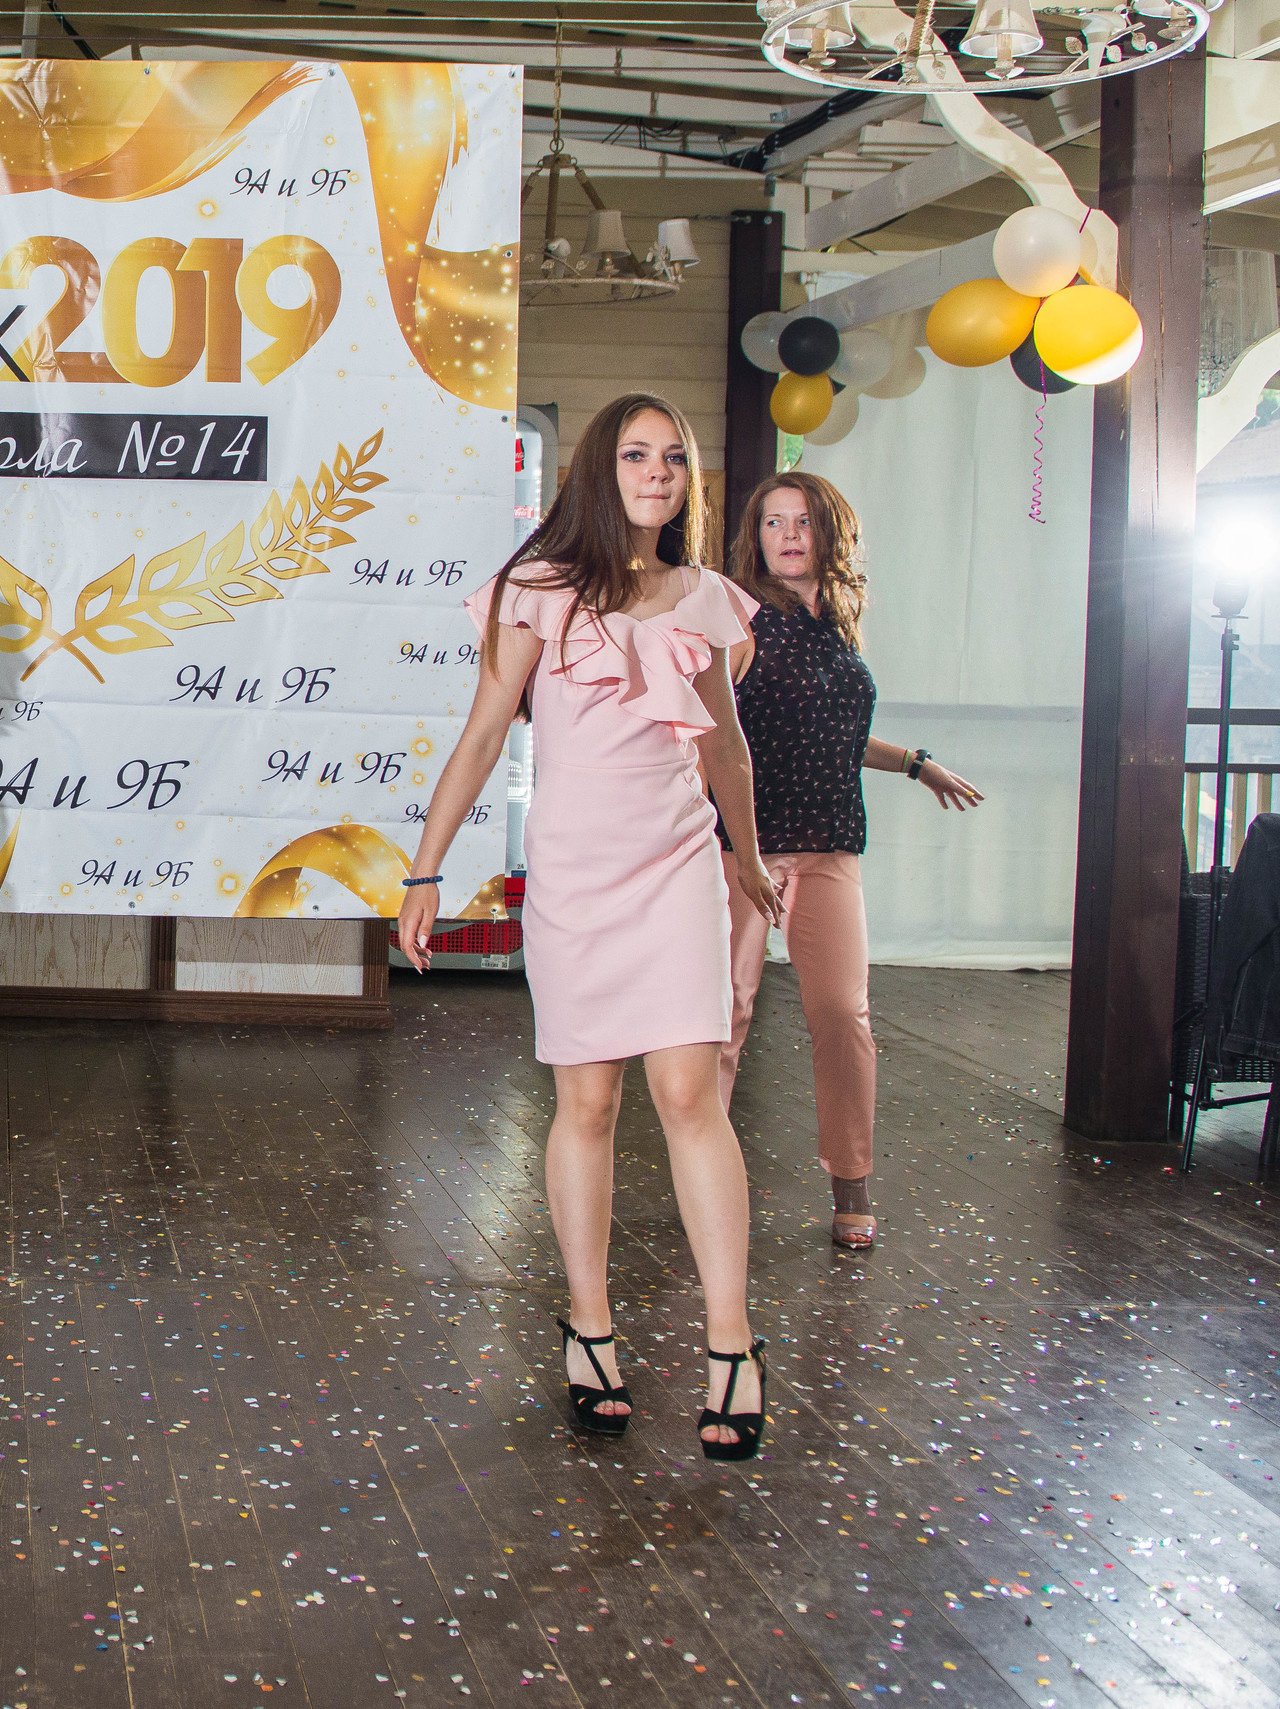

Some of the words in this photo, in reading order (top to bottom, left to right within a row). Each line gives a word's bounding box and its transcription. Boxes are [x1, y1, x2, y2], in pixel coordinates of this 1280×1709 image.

[230, 168, 271, 195] 9А
[278, 179, 298, 197] и
[307, 169, 351, 196] 9Б
[349, 559, 389, 585] 9А
[396, 569, 415, 586] и
[424, 560, 467, 586] 9Б
[397, 643, 428, 664] 9А
[433, 651, 448, 664] и
[169, 665, 226, 702] 9А
[236, 679, 263, 703] и
[276, 667, 336, 703] 9Б
[11, 701, 43, 721] 9Б
[262, 750, 311, 782] 9А
[320, 762, 344, 783] и
[355, 752, 407, 783] 9Б
[53, 776, 90, 809] и
[107, 760, 190, 810] 9Б
[77, 860, 116, 886] 9А
[124, 870, 143, 887] и
[151, 861, 193, 887] 9Б
